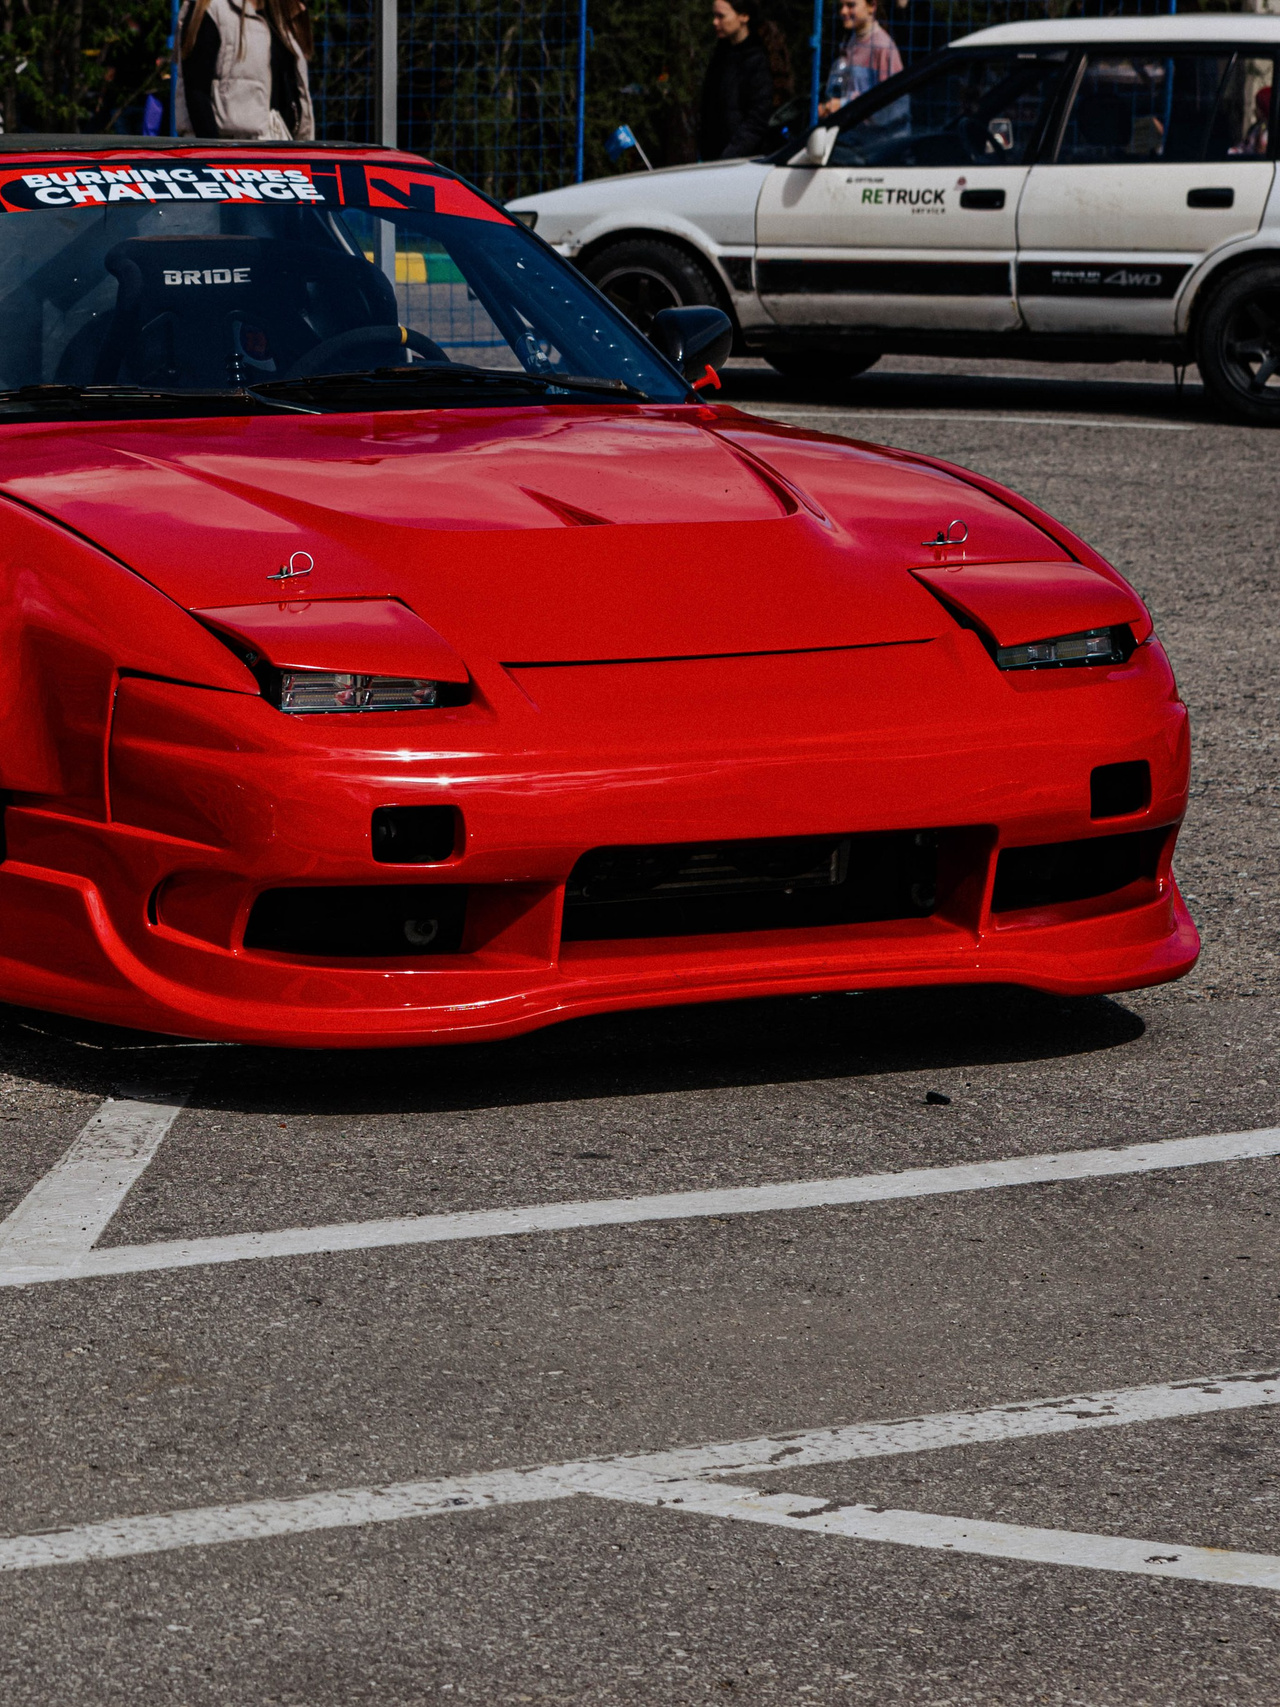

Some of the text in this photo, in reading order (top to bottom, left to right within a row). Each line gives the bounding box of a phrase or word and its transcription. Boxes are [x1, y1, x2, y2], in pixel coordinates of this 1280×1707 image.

[21, 168, 310, 188] BURNING TIRES
[33, 181, 325, 205] CHALLENGE
[861, 188, 946, 205] RETRUCK
[163, 267, 252, 286] BRIDE
[1102, 269, 1163, 287] 4WD
